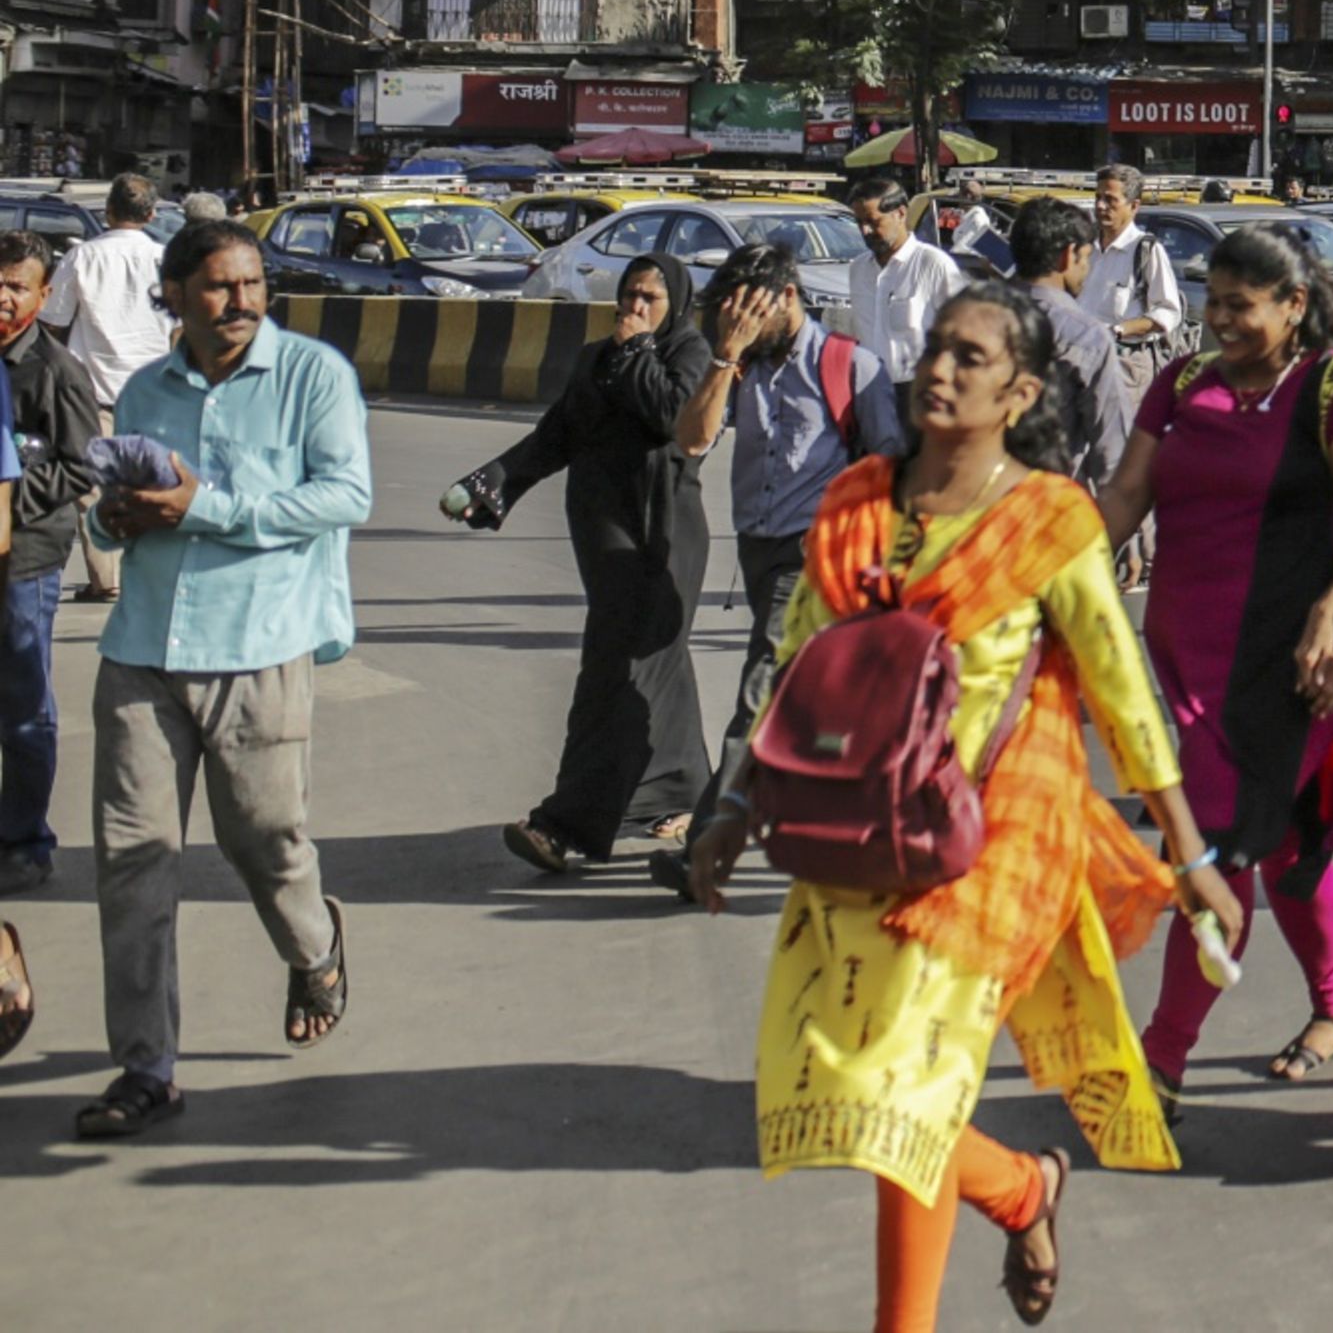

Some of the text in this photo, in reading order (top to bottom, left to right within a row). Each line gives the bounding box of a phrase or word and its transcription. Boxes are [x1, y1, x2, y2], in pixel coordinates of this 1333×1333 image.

[499, 78, 559, 101] राजश्री
[612, 87, 680, 98] COLLECTION
[977, 84, 1099, 103] NAJMI & CO.
[1121, 102, 1170, 123] LOOT
[1176, 102, 1195, 123] IS
[1200, 102, 1250, 123] LOOT
